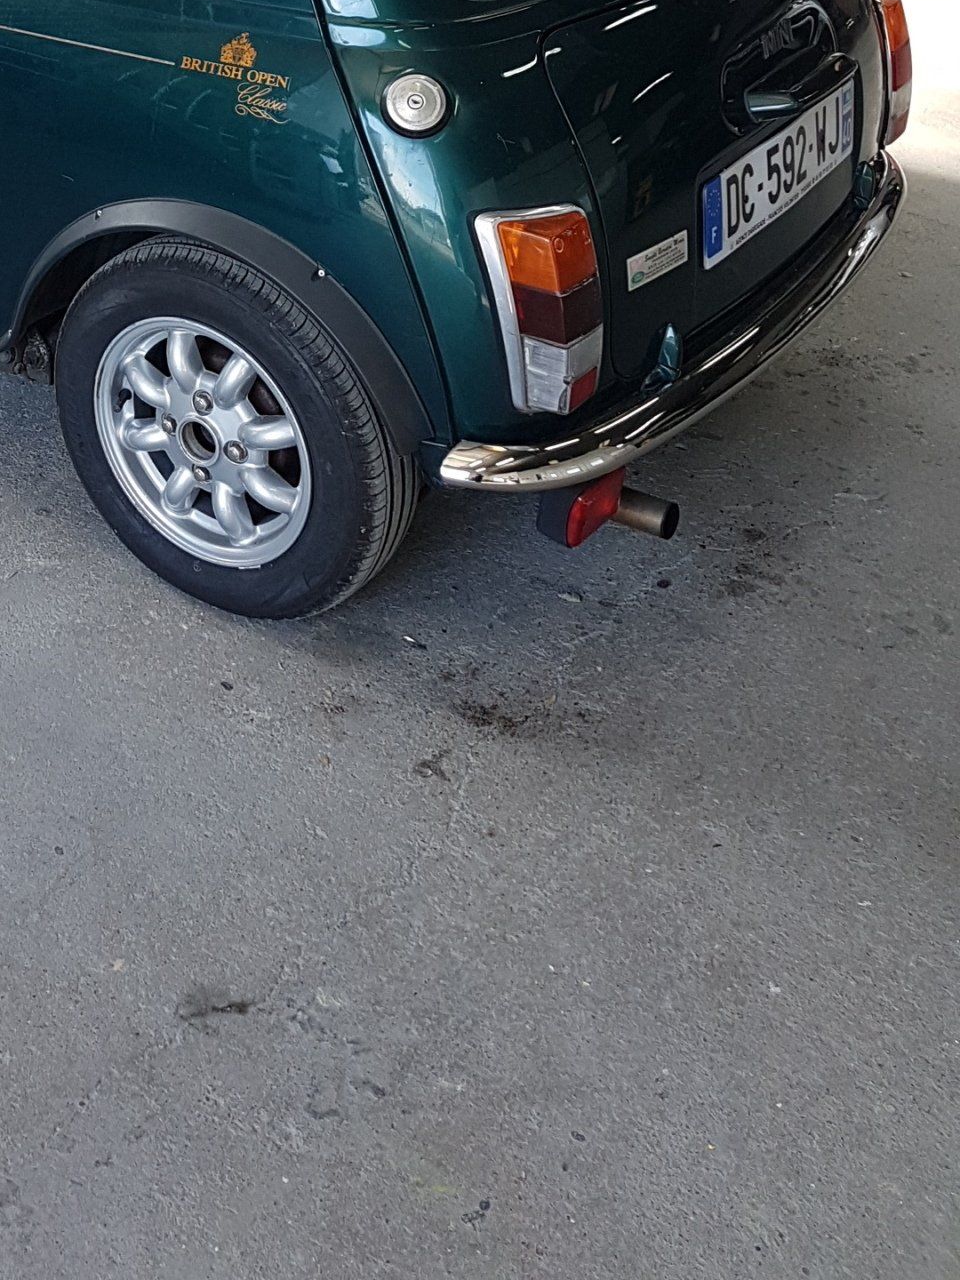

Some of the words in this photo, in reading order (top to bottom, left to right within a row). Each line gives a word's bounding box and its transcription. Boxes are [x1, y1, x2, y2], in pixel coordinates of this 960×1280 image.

[180, 56, 244, 80] BRITISH
[247, 69, 289, 89] OPEN
[237, 82, 288, 111] Classic
[710, 226, 719, 244] F
